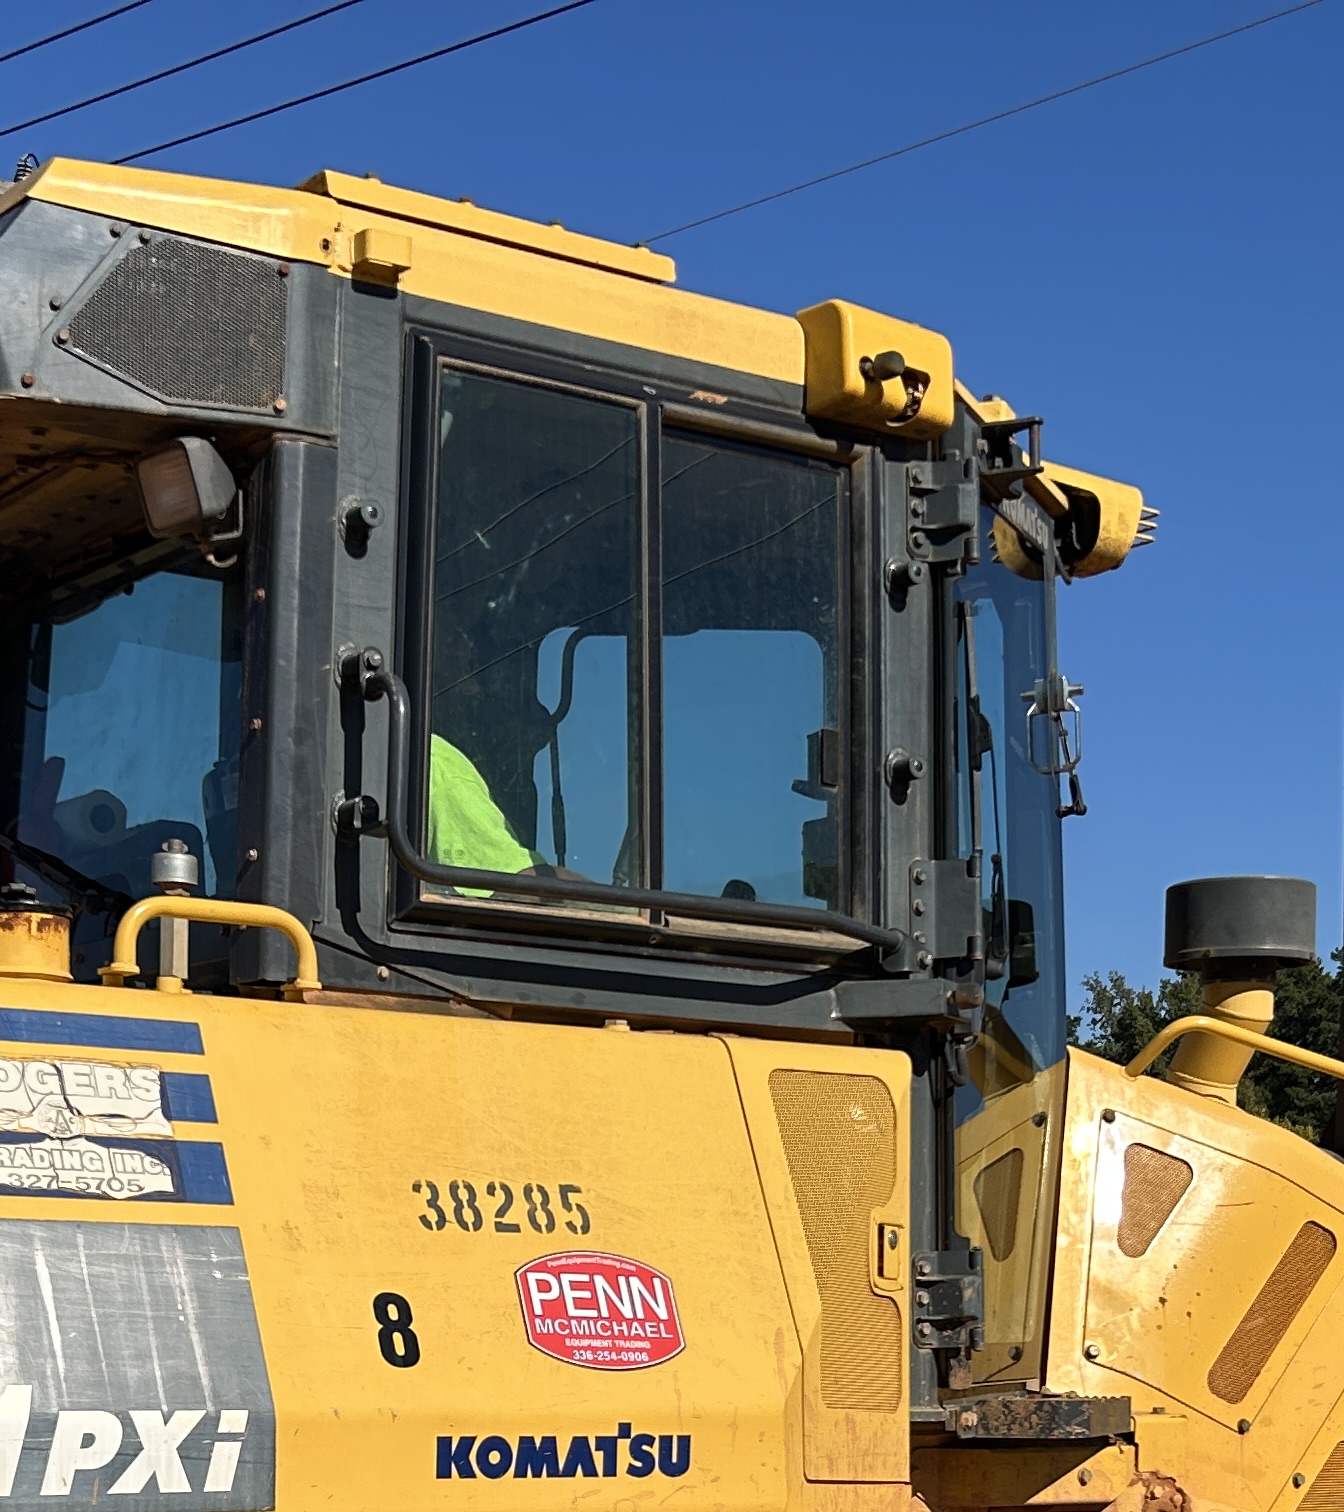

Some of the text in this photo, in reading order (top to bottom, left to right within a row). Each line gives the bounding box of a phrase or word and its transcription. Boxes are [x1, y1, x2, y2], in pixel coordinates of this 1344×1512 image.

[8, 1172, 145, 1193] 327-5705
[411, 1179, 592, 1236] 38285
[526, 1271, 669, 1320] PENN
[372, 1292, 421, 1368] 8
[534, 1318, 674, 1339] MCMICHAEL
[564, 1337, 651, 1349] EQUIPMENT TRADING
[572, 1349, 649, 1362] 336-254-0906
[436, 1422, 692, 1479] KOMATSU
